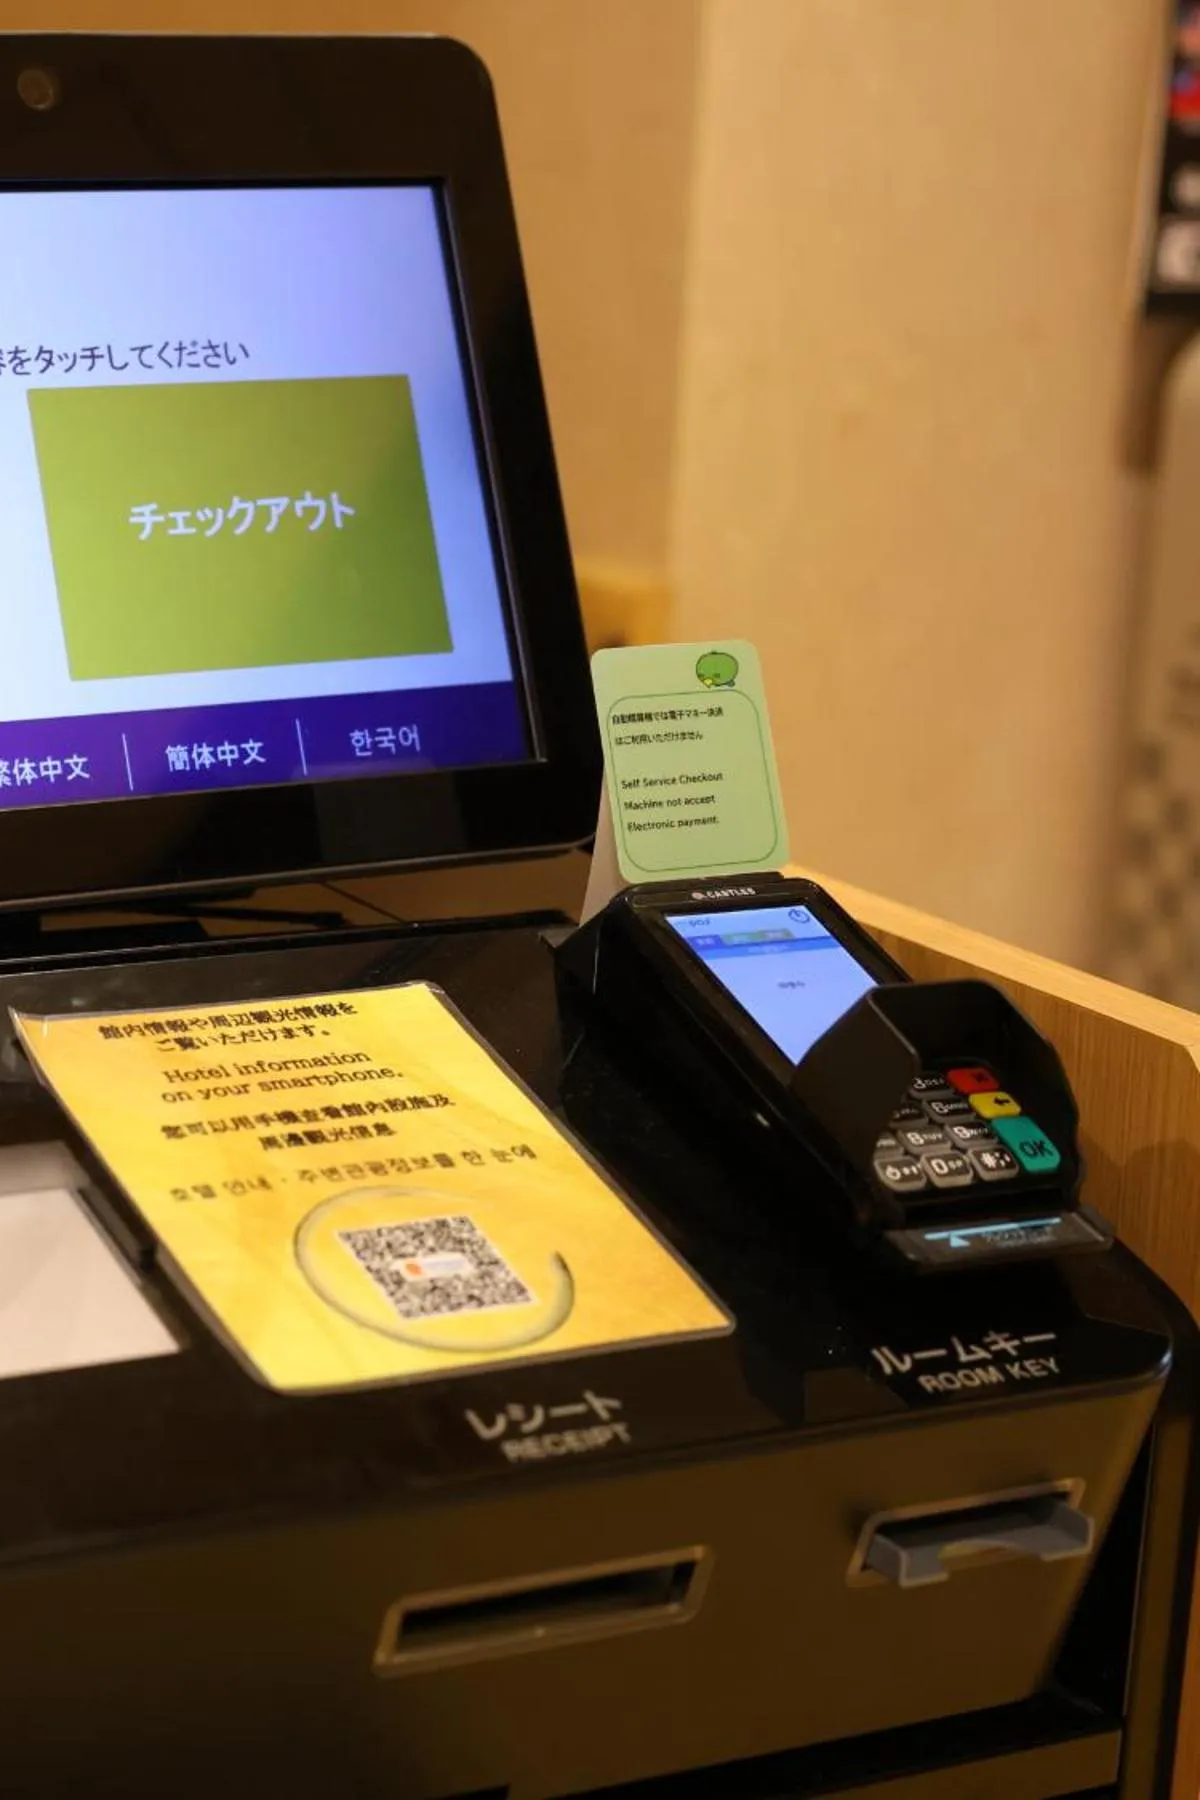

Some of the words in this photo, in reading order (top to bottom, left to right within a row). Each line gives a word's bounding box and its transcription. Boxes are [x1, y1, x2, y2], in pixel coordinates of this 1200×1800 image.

[130, 492, 355, 540] チェックアウト
[165, 739, 266, 772] 簡体中文
[349, 724, 421, 756] 한국어
[621, 778, 640, 789] Self
[643, 777, 676, 788] Service
[679, 772, 723, 785] Checkout
[624, 799, 663, 810] Machine
[666, 798, 682, 807] not
[684, 795, 715, 806] accept
[627, 819, 676, 832] Electronic
[706, 887, 756, 899] CASTLES
[156, 1023, 330, 1052] ご覧いただけます。
[163, 1065, 229, 1085] Hotel
[237, 1050, 371, 1076] information
[161, 1088, 194, 1105] on
[198, 1083, 252, 1101] your
[258, 1065, 404, 1092] smartphone.
[1019, 1140, 1053, 1158] OK
[870, 1330, 1057, 1375] ルームキー
[917, 1364, 1005, 1393] ROOM
[1005, 1356, 1060, 1380] KEY
[463, 1389, 623, 1441] レシート
[501, 1421, 632, 1464] RECEIPT
